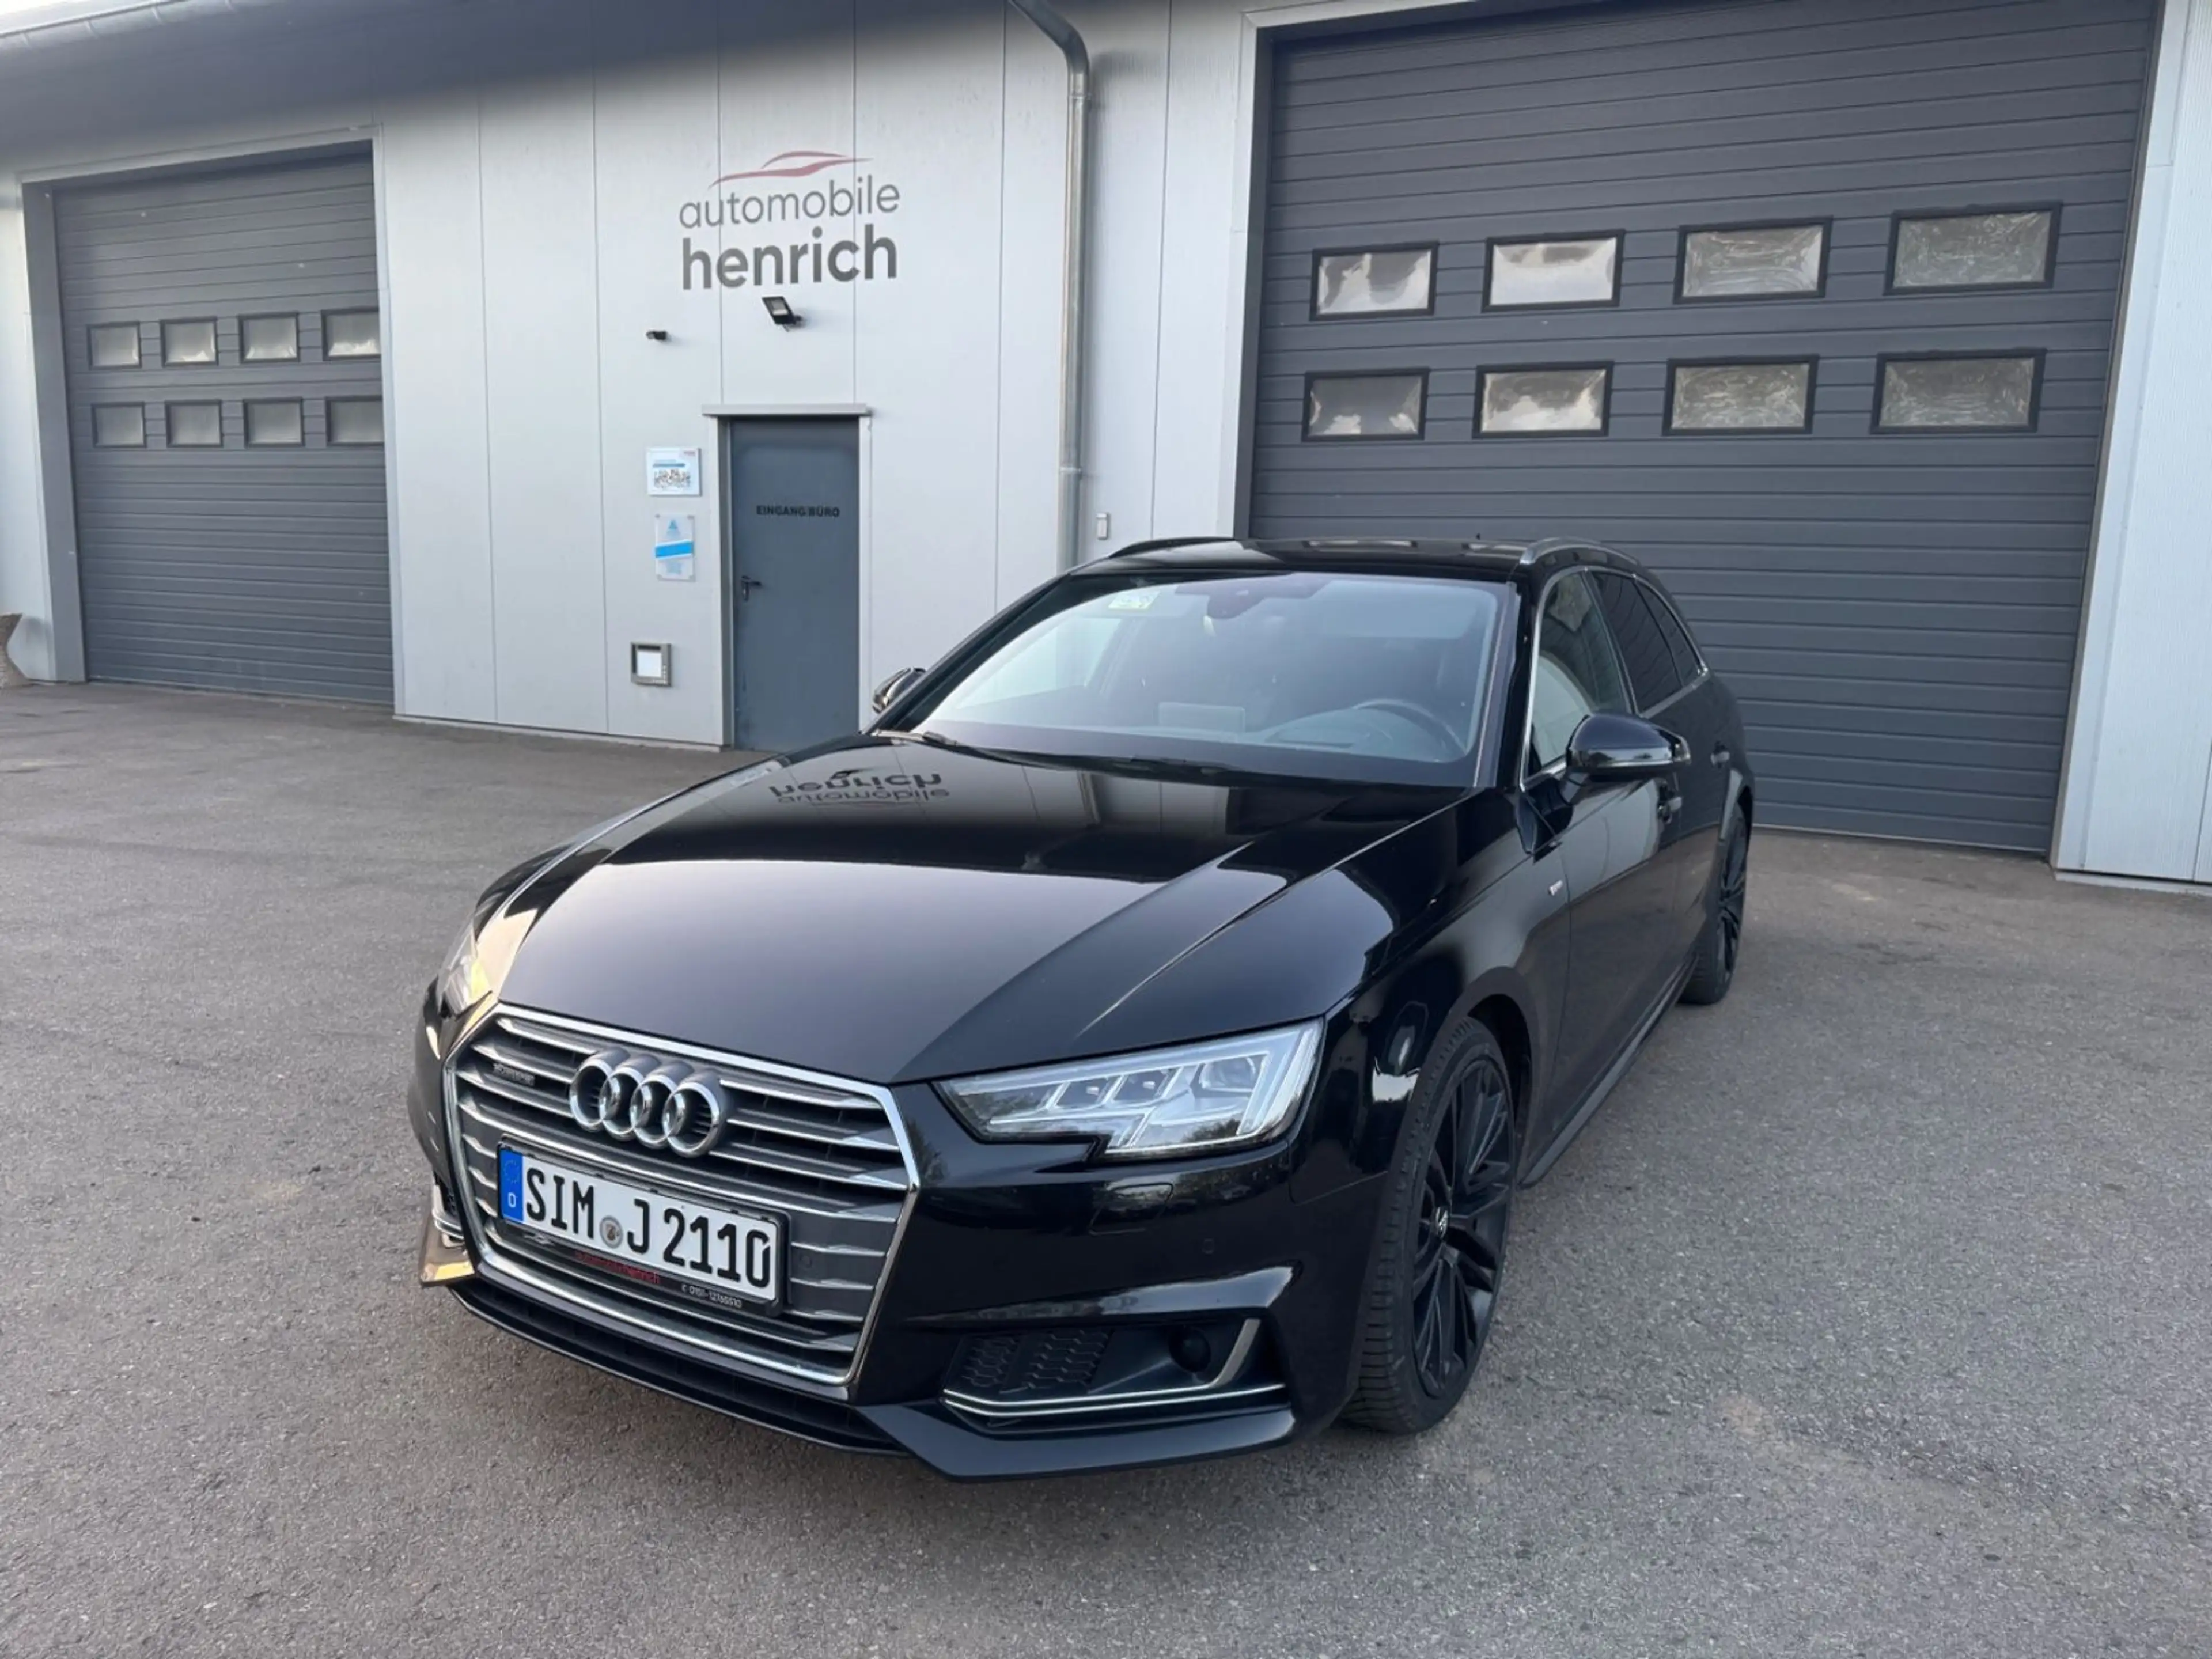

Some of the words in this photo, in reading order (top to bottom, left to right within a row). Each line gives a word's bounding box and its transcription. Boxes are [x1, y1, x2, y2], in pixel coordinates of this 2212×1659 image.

[679, 175, 900, 229] automobile
[682, 224, 897, 290] henrich
[756, 504, 805, 516] EINGANG
[809, 505, 840, 517] BÜRO
[527, 1168, 594, 1239] SIM
[627, 1198, 650, 1255] J
[663, 1208, 770, 1288] 2110
